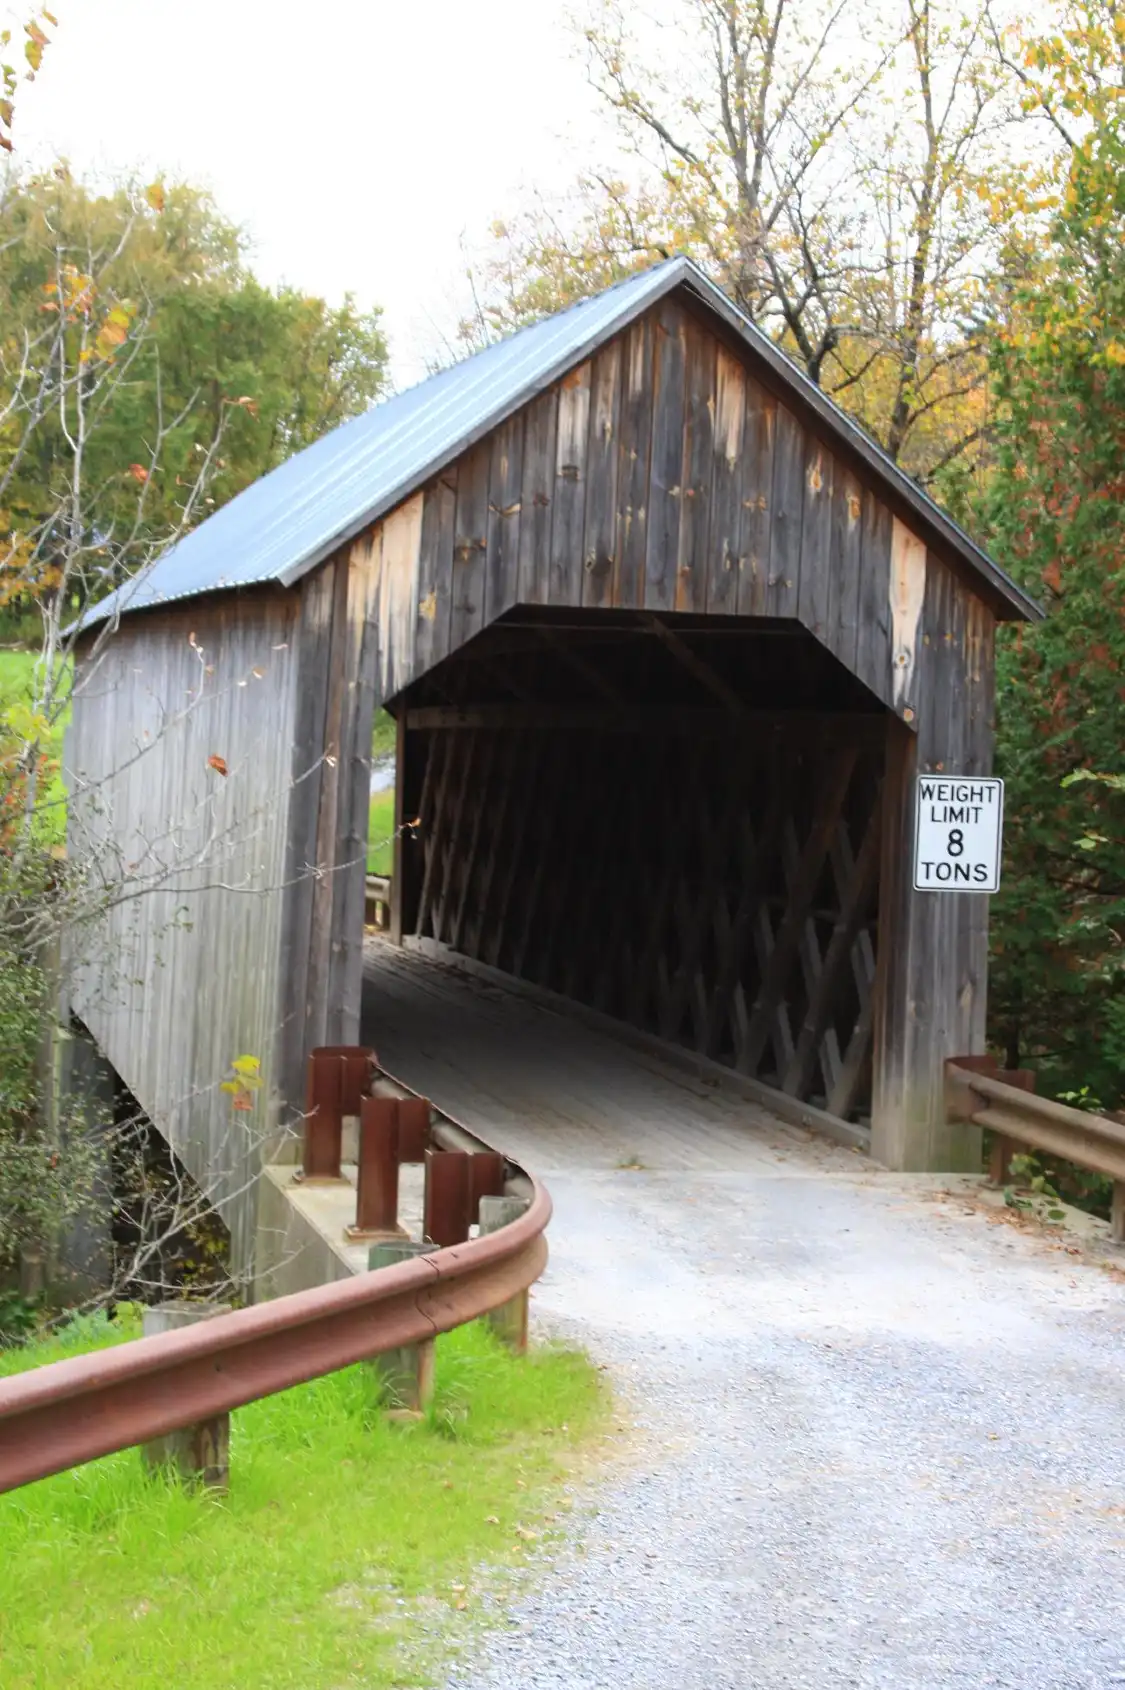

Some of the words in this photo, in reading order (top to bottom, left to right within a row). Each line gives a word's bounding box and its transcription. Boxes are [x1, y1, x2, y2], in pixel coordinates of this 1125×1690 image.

[920, 784, 996, 803] WEIGHT
[931, 805, 983, 824] LIMIT
[947, 828, 964, 857] 8
[921, 862, 988, 882] TONS
